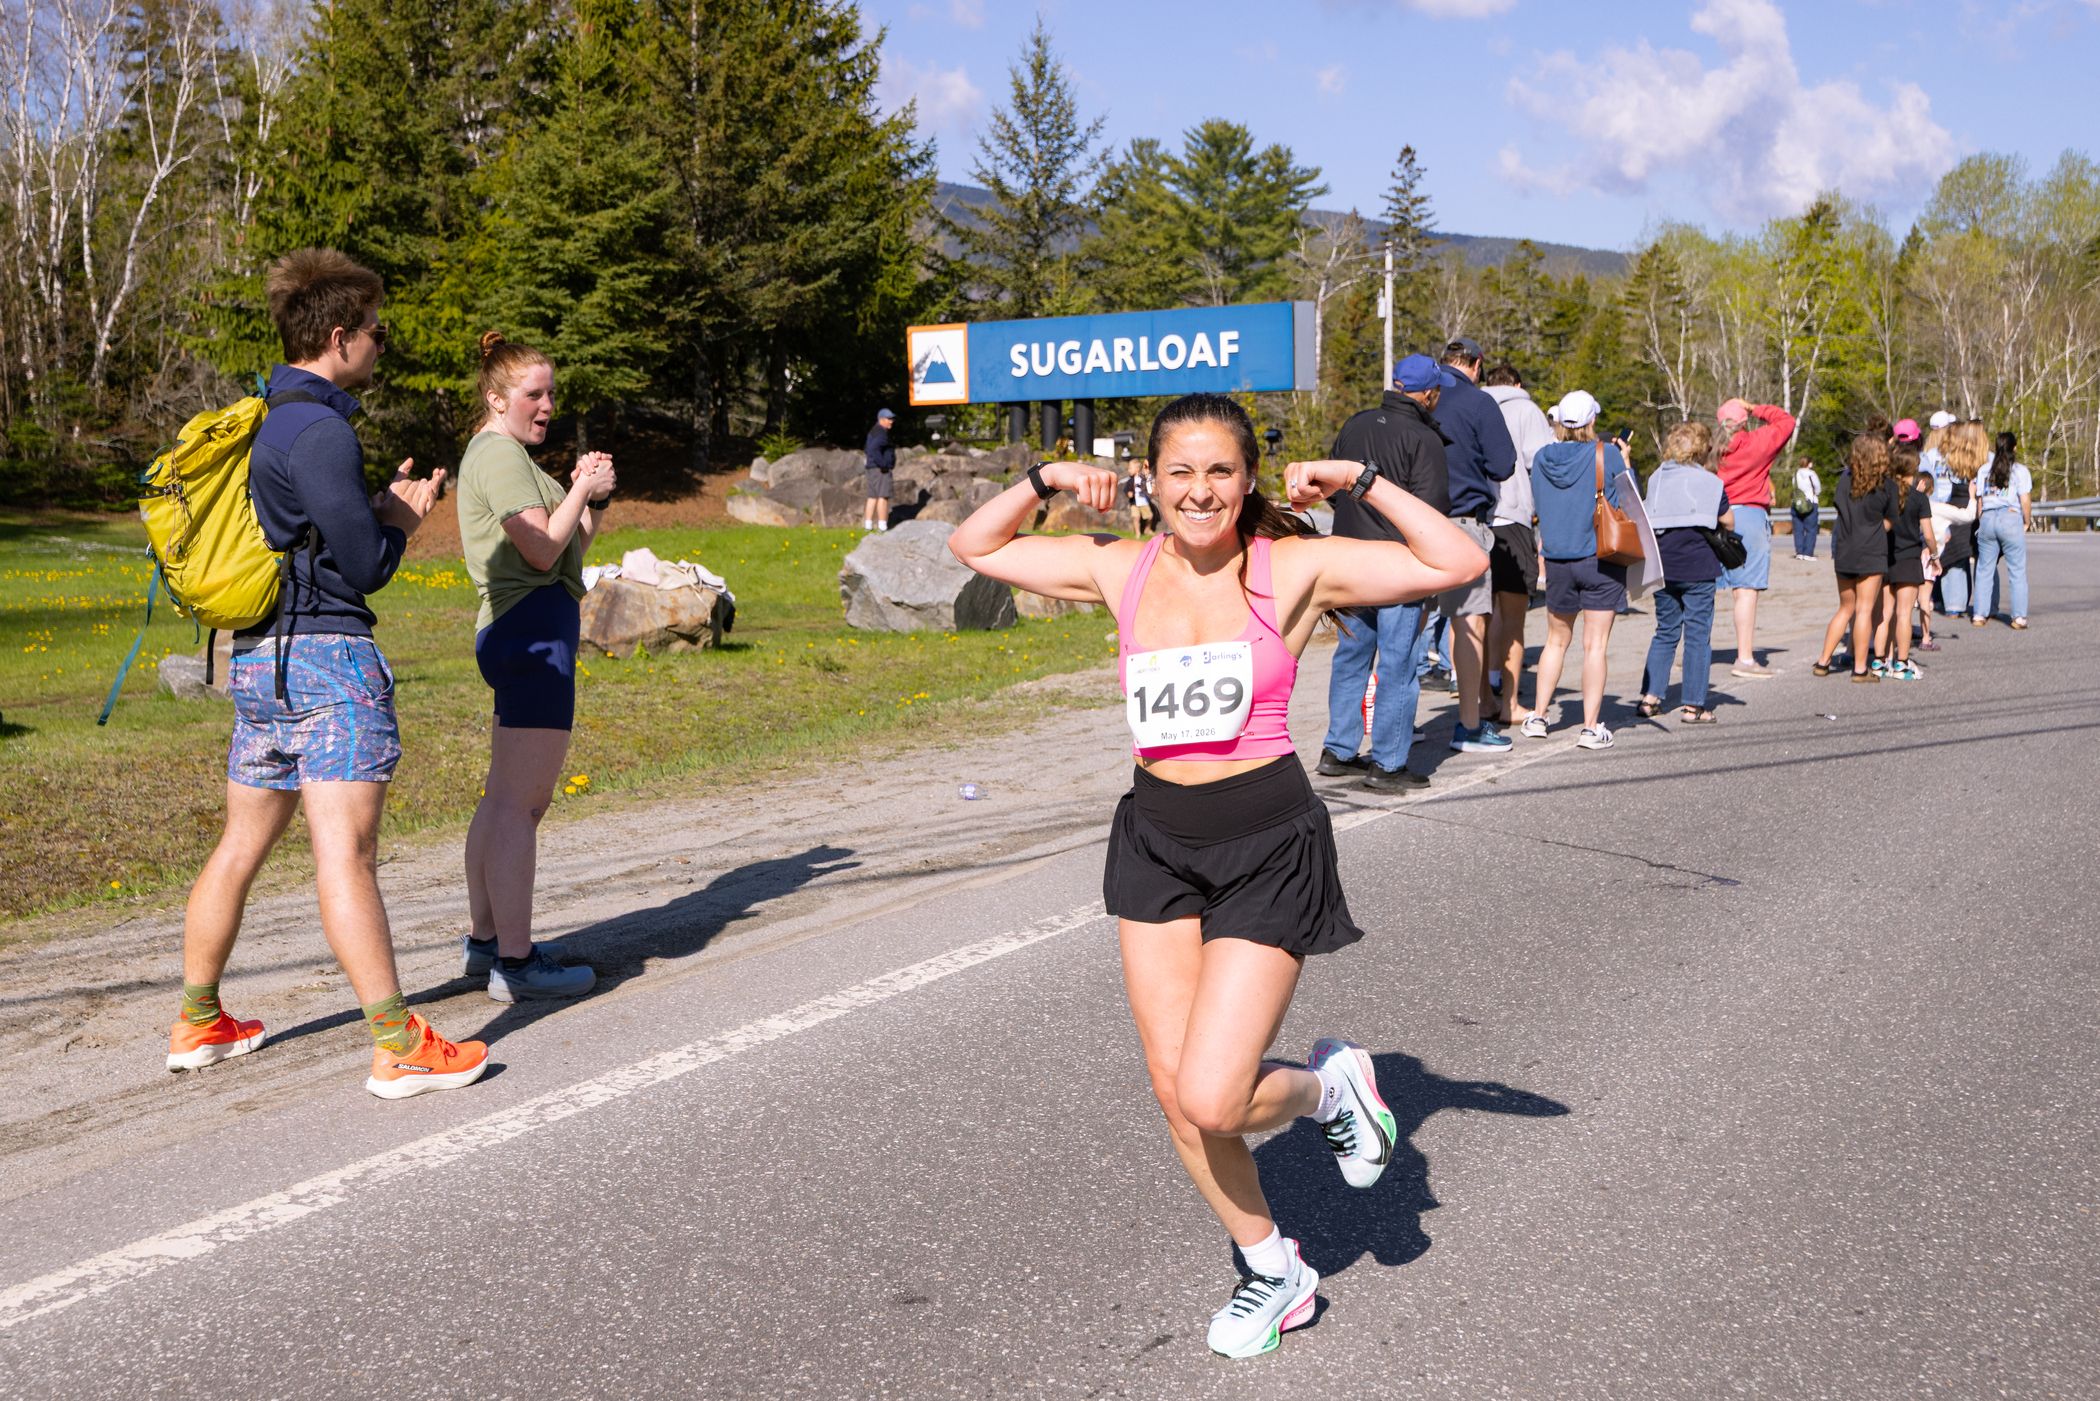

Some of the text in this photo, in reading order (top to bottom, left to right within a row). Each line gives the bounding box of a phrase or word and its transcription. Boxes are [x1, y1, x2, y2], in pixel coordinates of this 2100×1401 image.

[1009, 330, 1240, 378] SUGARLOAF
[1134, 677, 1244, 723] 1469
[1161, 728, 1216, 741] May 17, 2026
[398, 1063, 430, 1072] SALOMON
